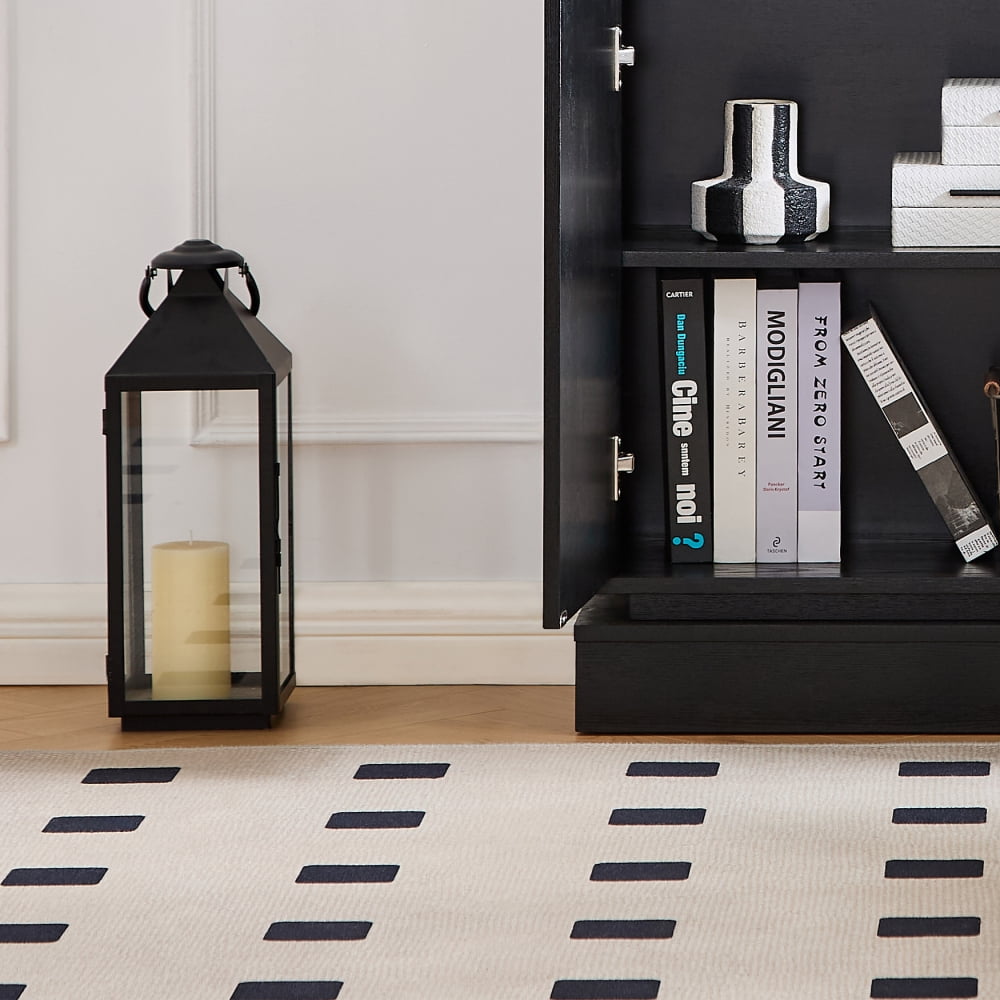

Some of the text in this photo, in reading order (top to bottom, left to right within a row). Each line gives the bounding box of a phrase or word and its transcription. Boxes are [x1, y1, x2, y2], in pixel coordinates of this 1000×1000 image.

[676, 313, 687, 375] Dan Dungaciu
[767, 310, 786, 438] MODIGLIANI
[672, 380, 698, 437] Cine
[812, 315, 828, 490] FROM ZERO START
[676, 483, 702, 524] noi
